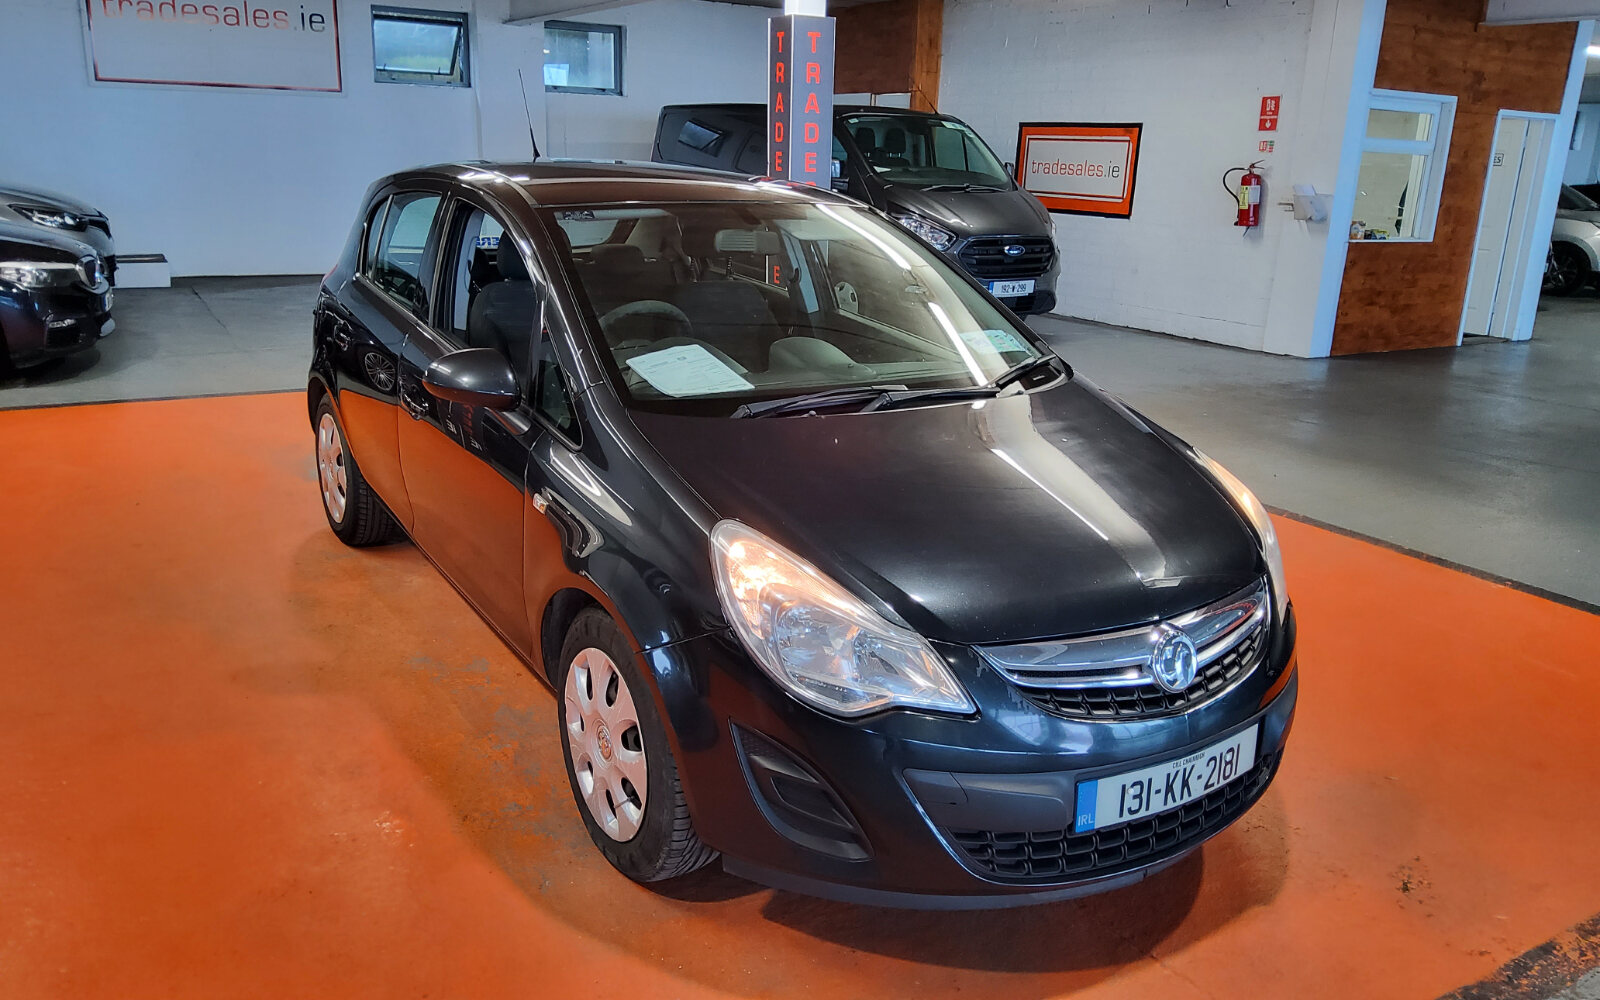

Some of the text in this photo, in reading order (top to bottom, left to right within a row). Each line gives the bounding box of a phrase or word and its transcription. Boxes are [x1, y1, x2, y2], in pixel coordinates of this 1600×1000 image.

[103, 0, 325, 32] tradesales.ie
[775, 31, 784, 171] TRADE
[804, 32, 821, 172] TRADE
[1032, 160, 1120, 178] tradesales.ie
[1119, 743, 1240, 818] 131-KK-2181
[1077, 814, 1094, 827] IRL
